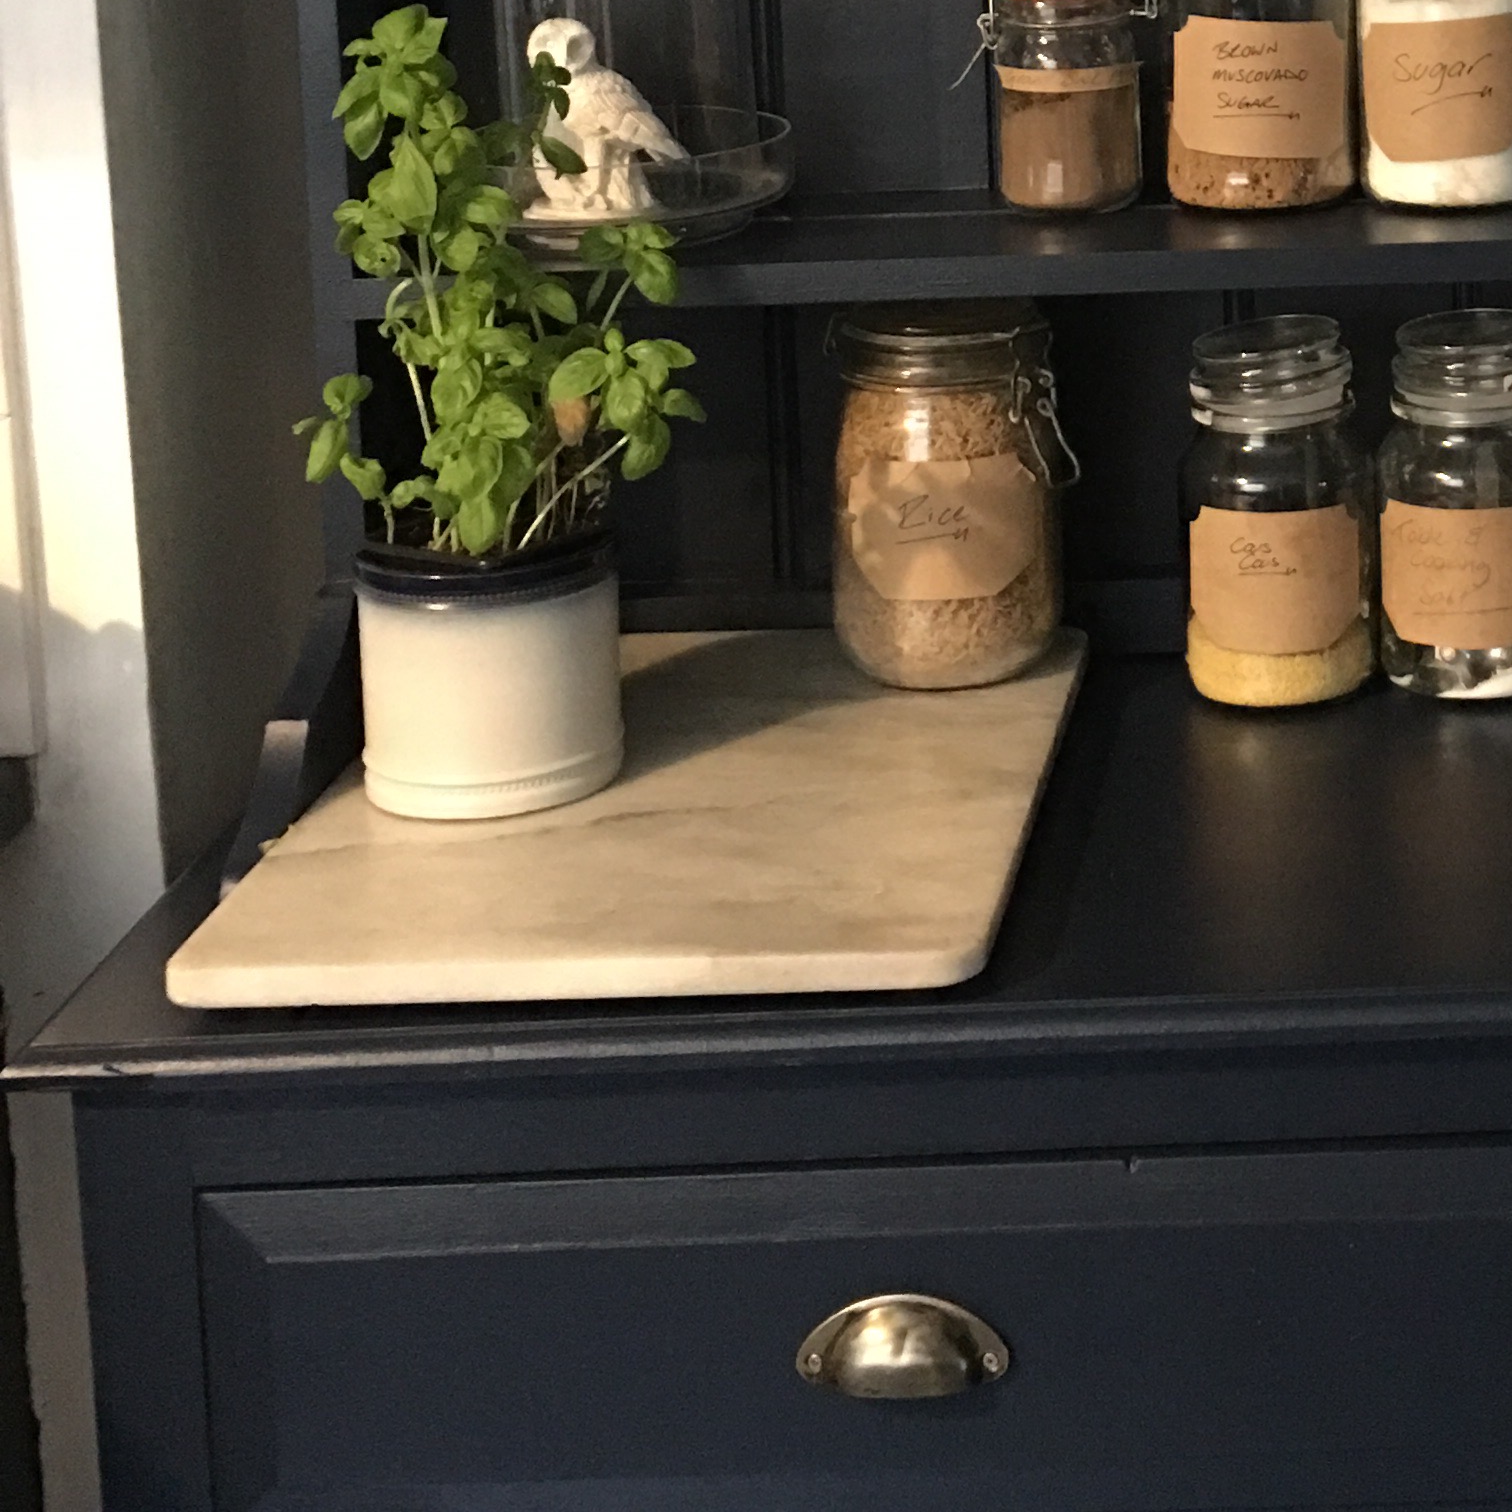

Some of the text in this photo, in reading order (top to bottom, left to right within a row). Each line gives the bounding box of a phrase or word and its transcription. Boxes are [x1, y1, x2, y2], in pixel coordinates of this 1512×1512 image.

[1212, 40, 1280, 61] BROWN
[1211, 67, 1309, 83] MUSCOVADO
[1392, 52, 1494, 95] Sugar
[1215, 92, 1281, 110] SUGAR
[897, 494, 966, 531] Rice
